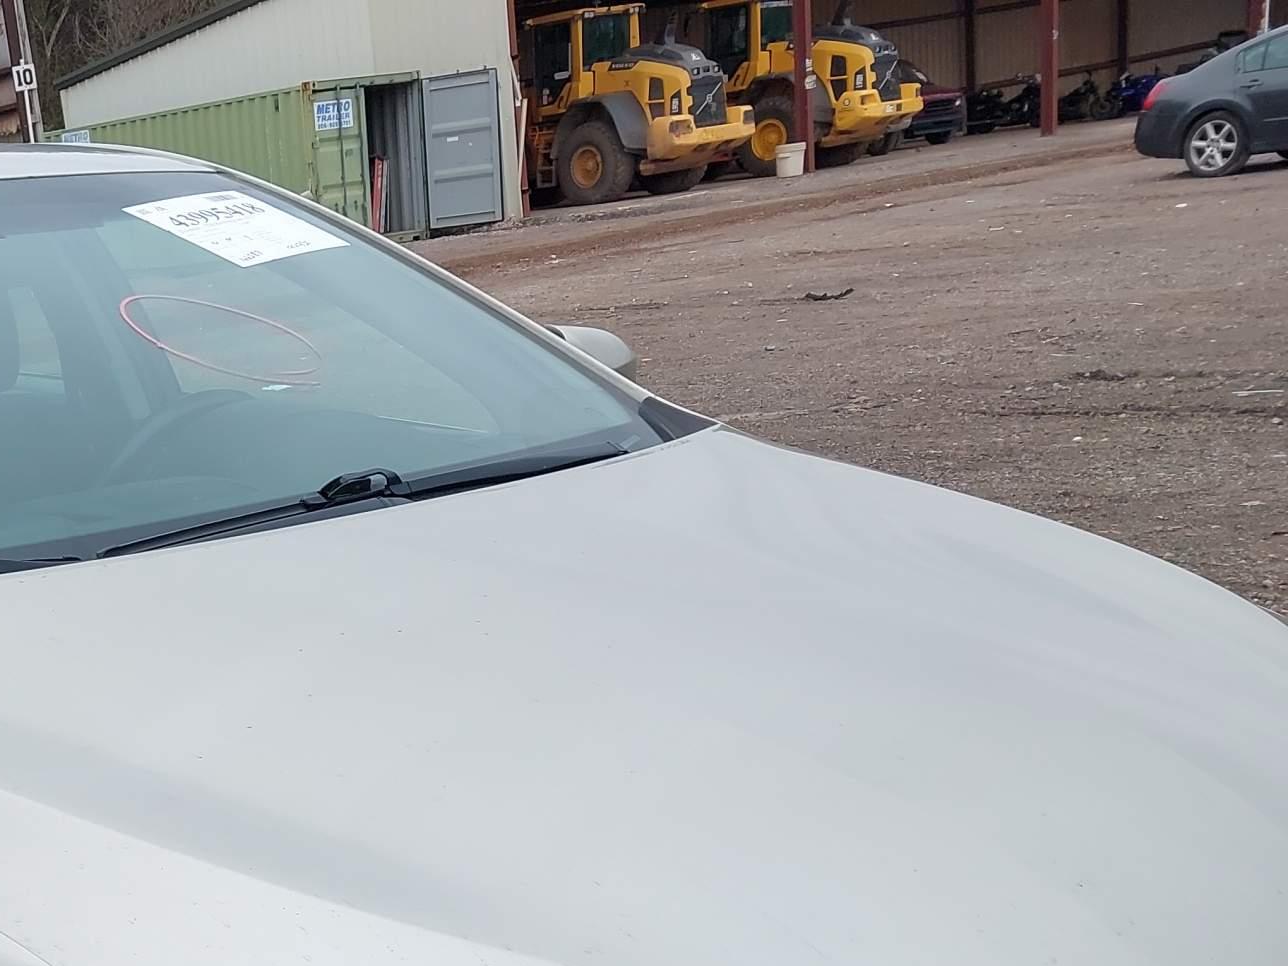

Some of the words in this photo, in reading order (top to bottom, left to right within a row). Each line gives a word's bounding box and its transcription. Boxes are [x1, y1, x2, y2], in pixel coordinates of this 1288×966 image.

[15, 68, 33, 87] 10
[316, 101, 351, 114] METRO
[168, 202, 265, 227] 43995418
